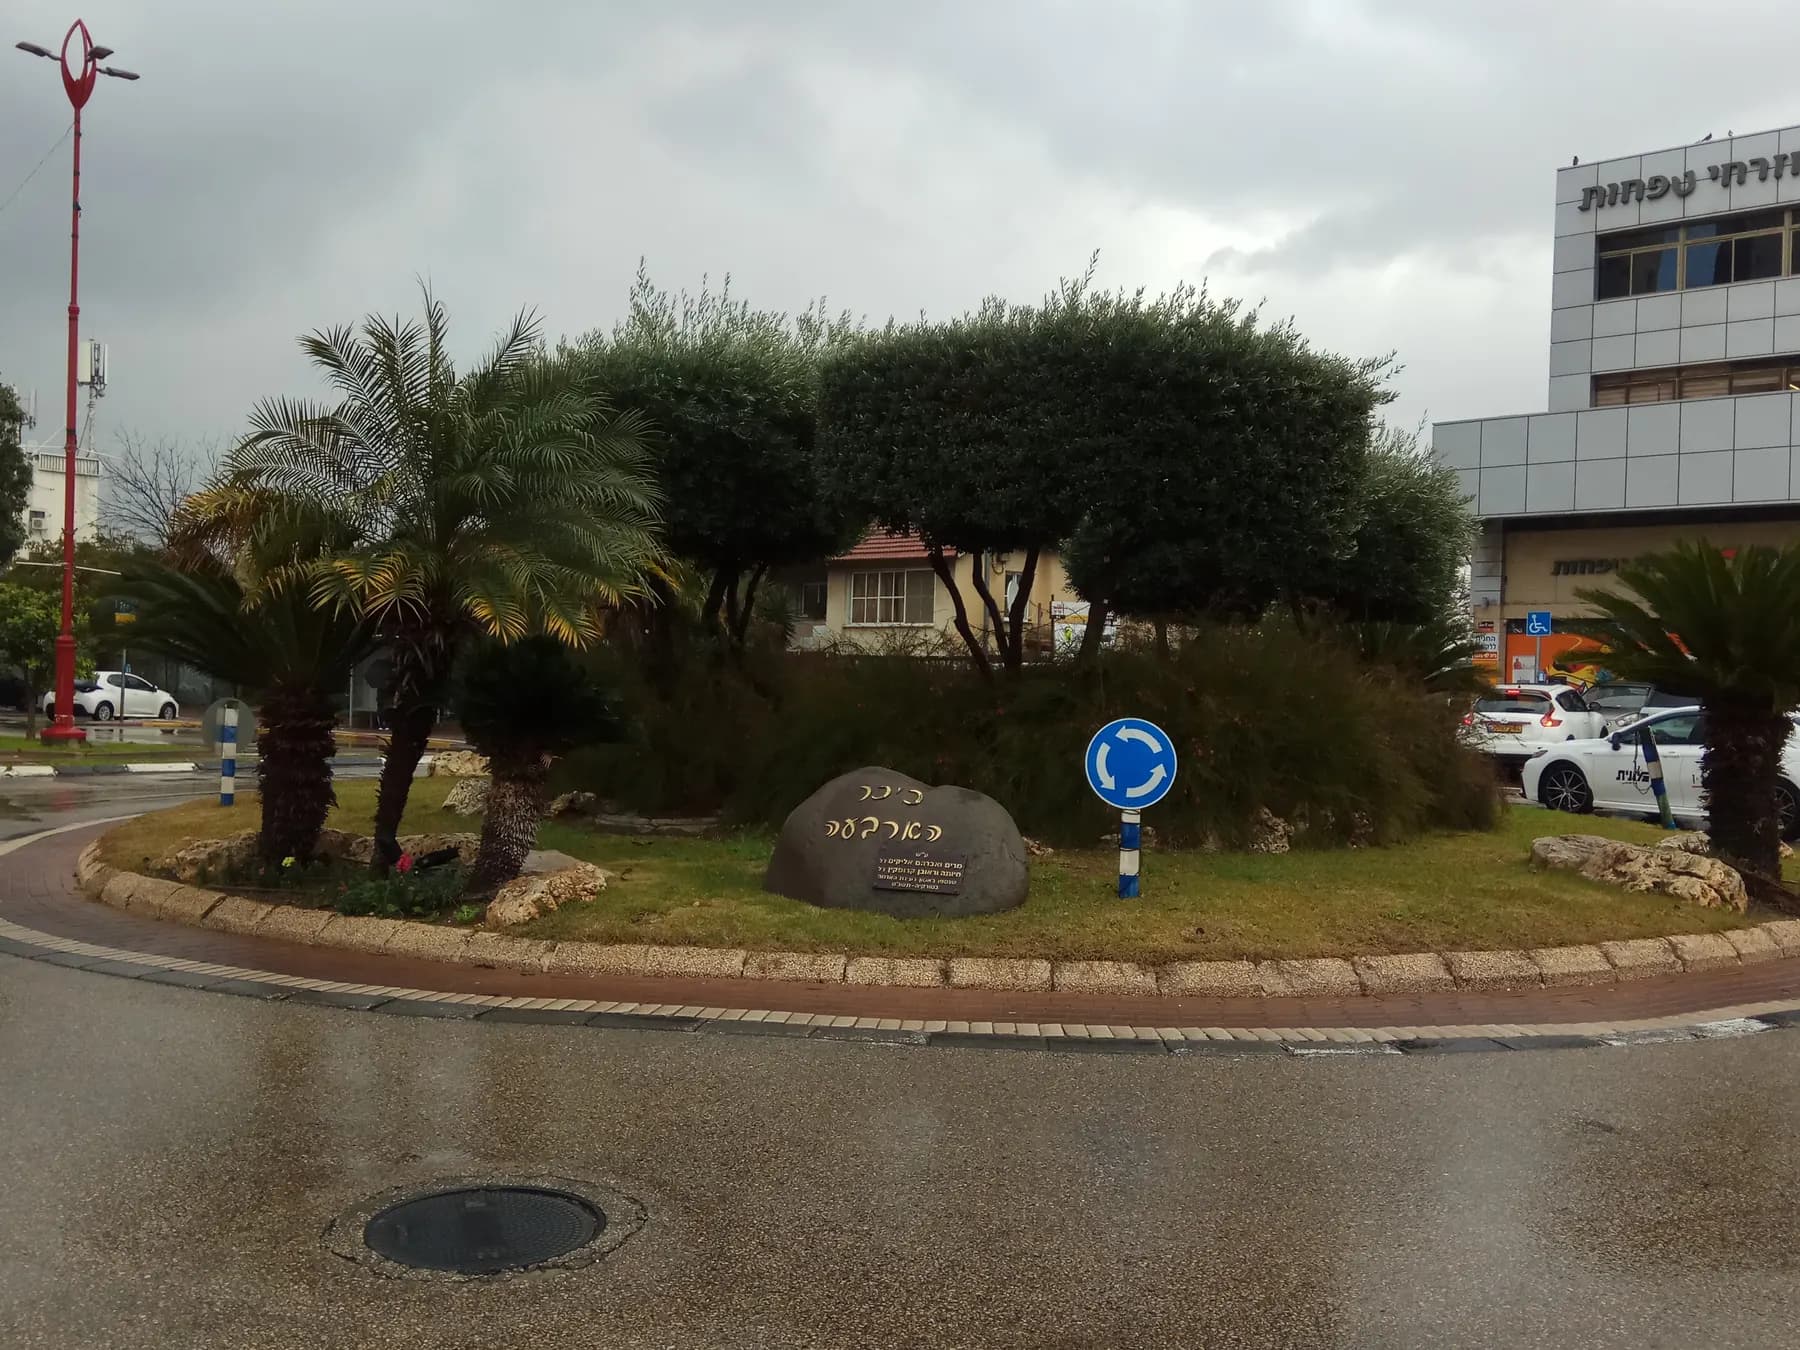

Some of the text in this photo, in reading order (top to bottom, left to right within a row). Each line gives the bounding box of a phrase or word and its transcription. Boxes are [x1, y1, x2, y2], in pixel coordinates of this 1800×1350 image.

[1577, 169, 1697, 212] טפחות
[859, 785, 923, 805] כיכר
[825, 816, 943, 842] הארבעה
[915, 859, 943, 868] ואברהם
[944, 862, 963, 870] מרים
